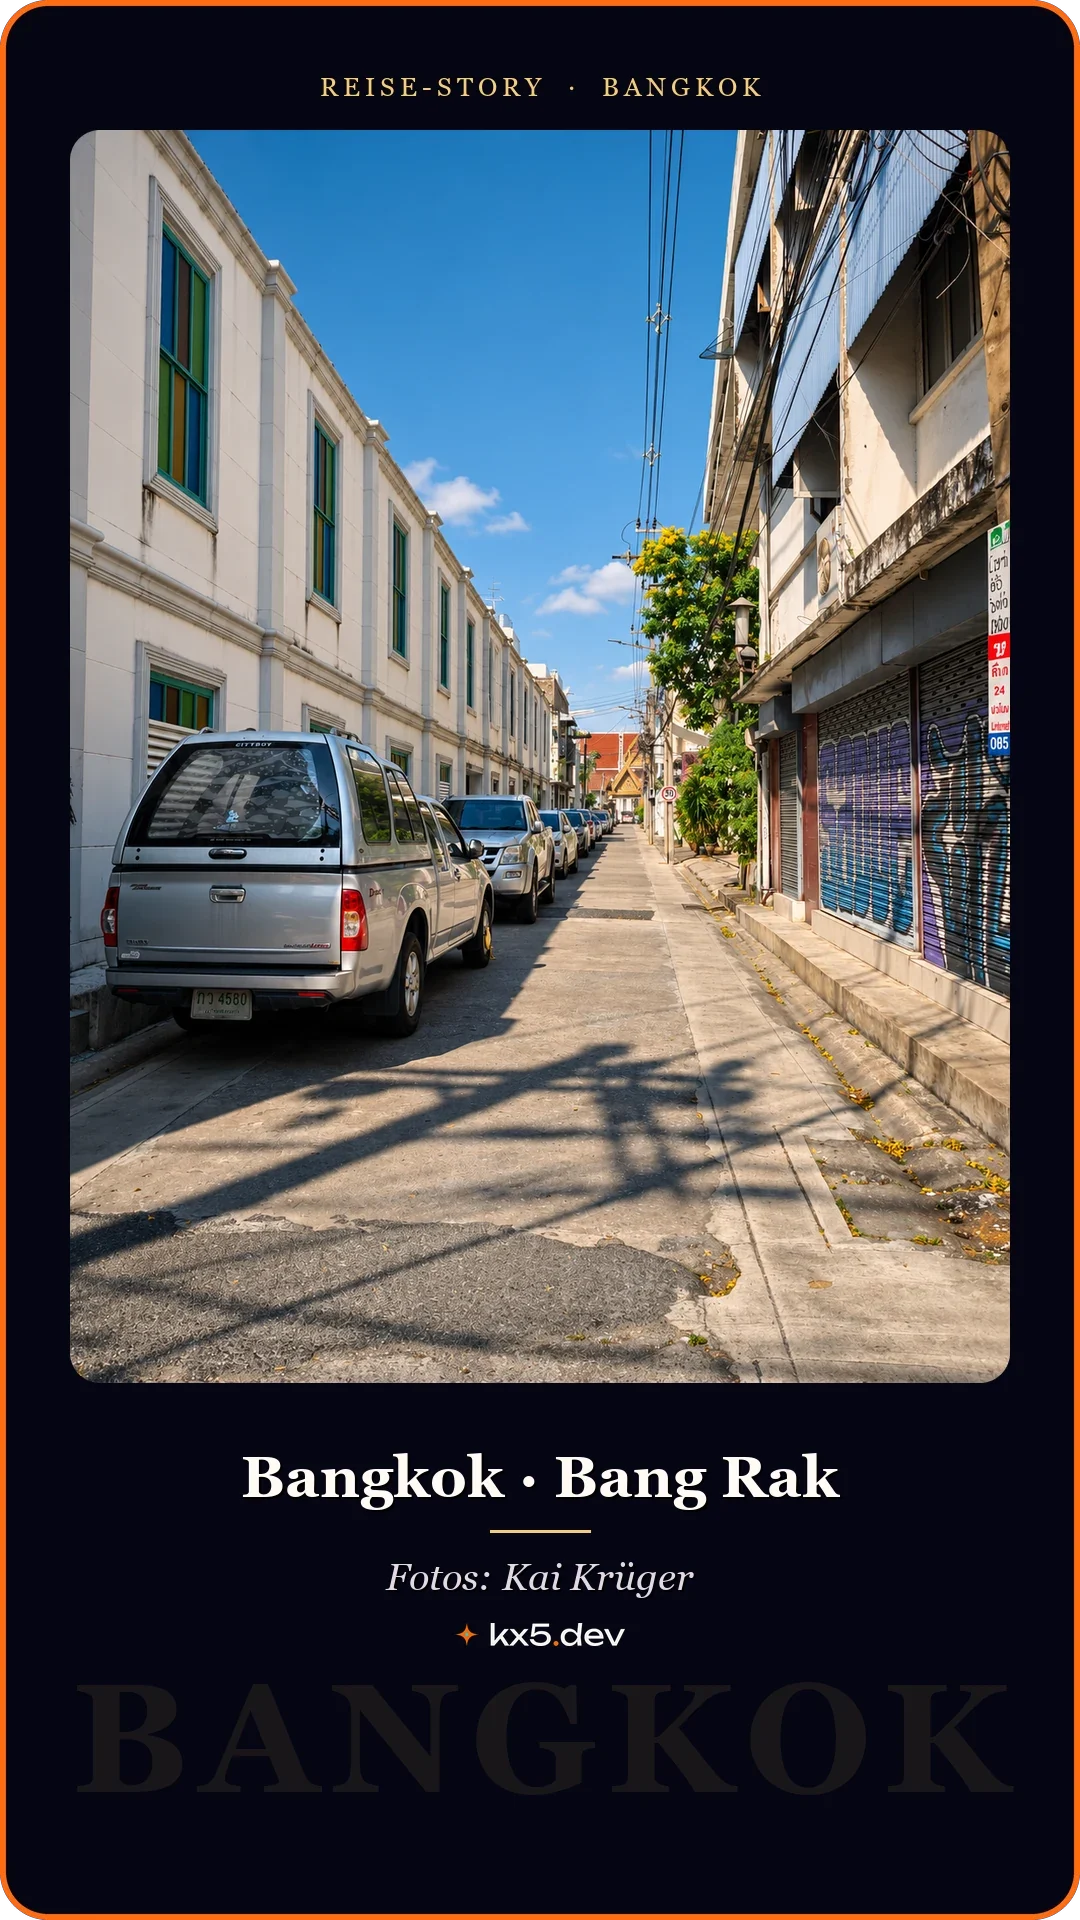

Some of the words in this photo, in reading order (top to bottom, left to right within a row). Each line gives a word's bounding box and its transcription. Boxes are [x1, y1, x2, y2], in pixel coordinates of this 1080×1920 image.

[994, 685, 1006, 697] 24
[990, 736, 1009, 751] 085
[217, 992, 248, 1006] 4580
